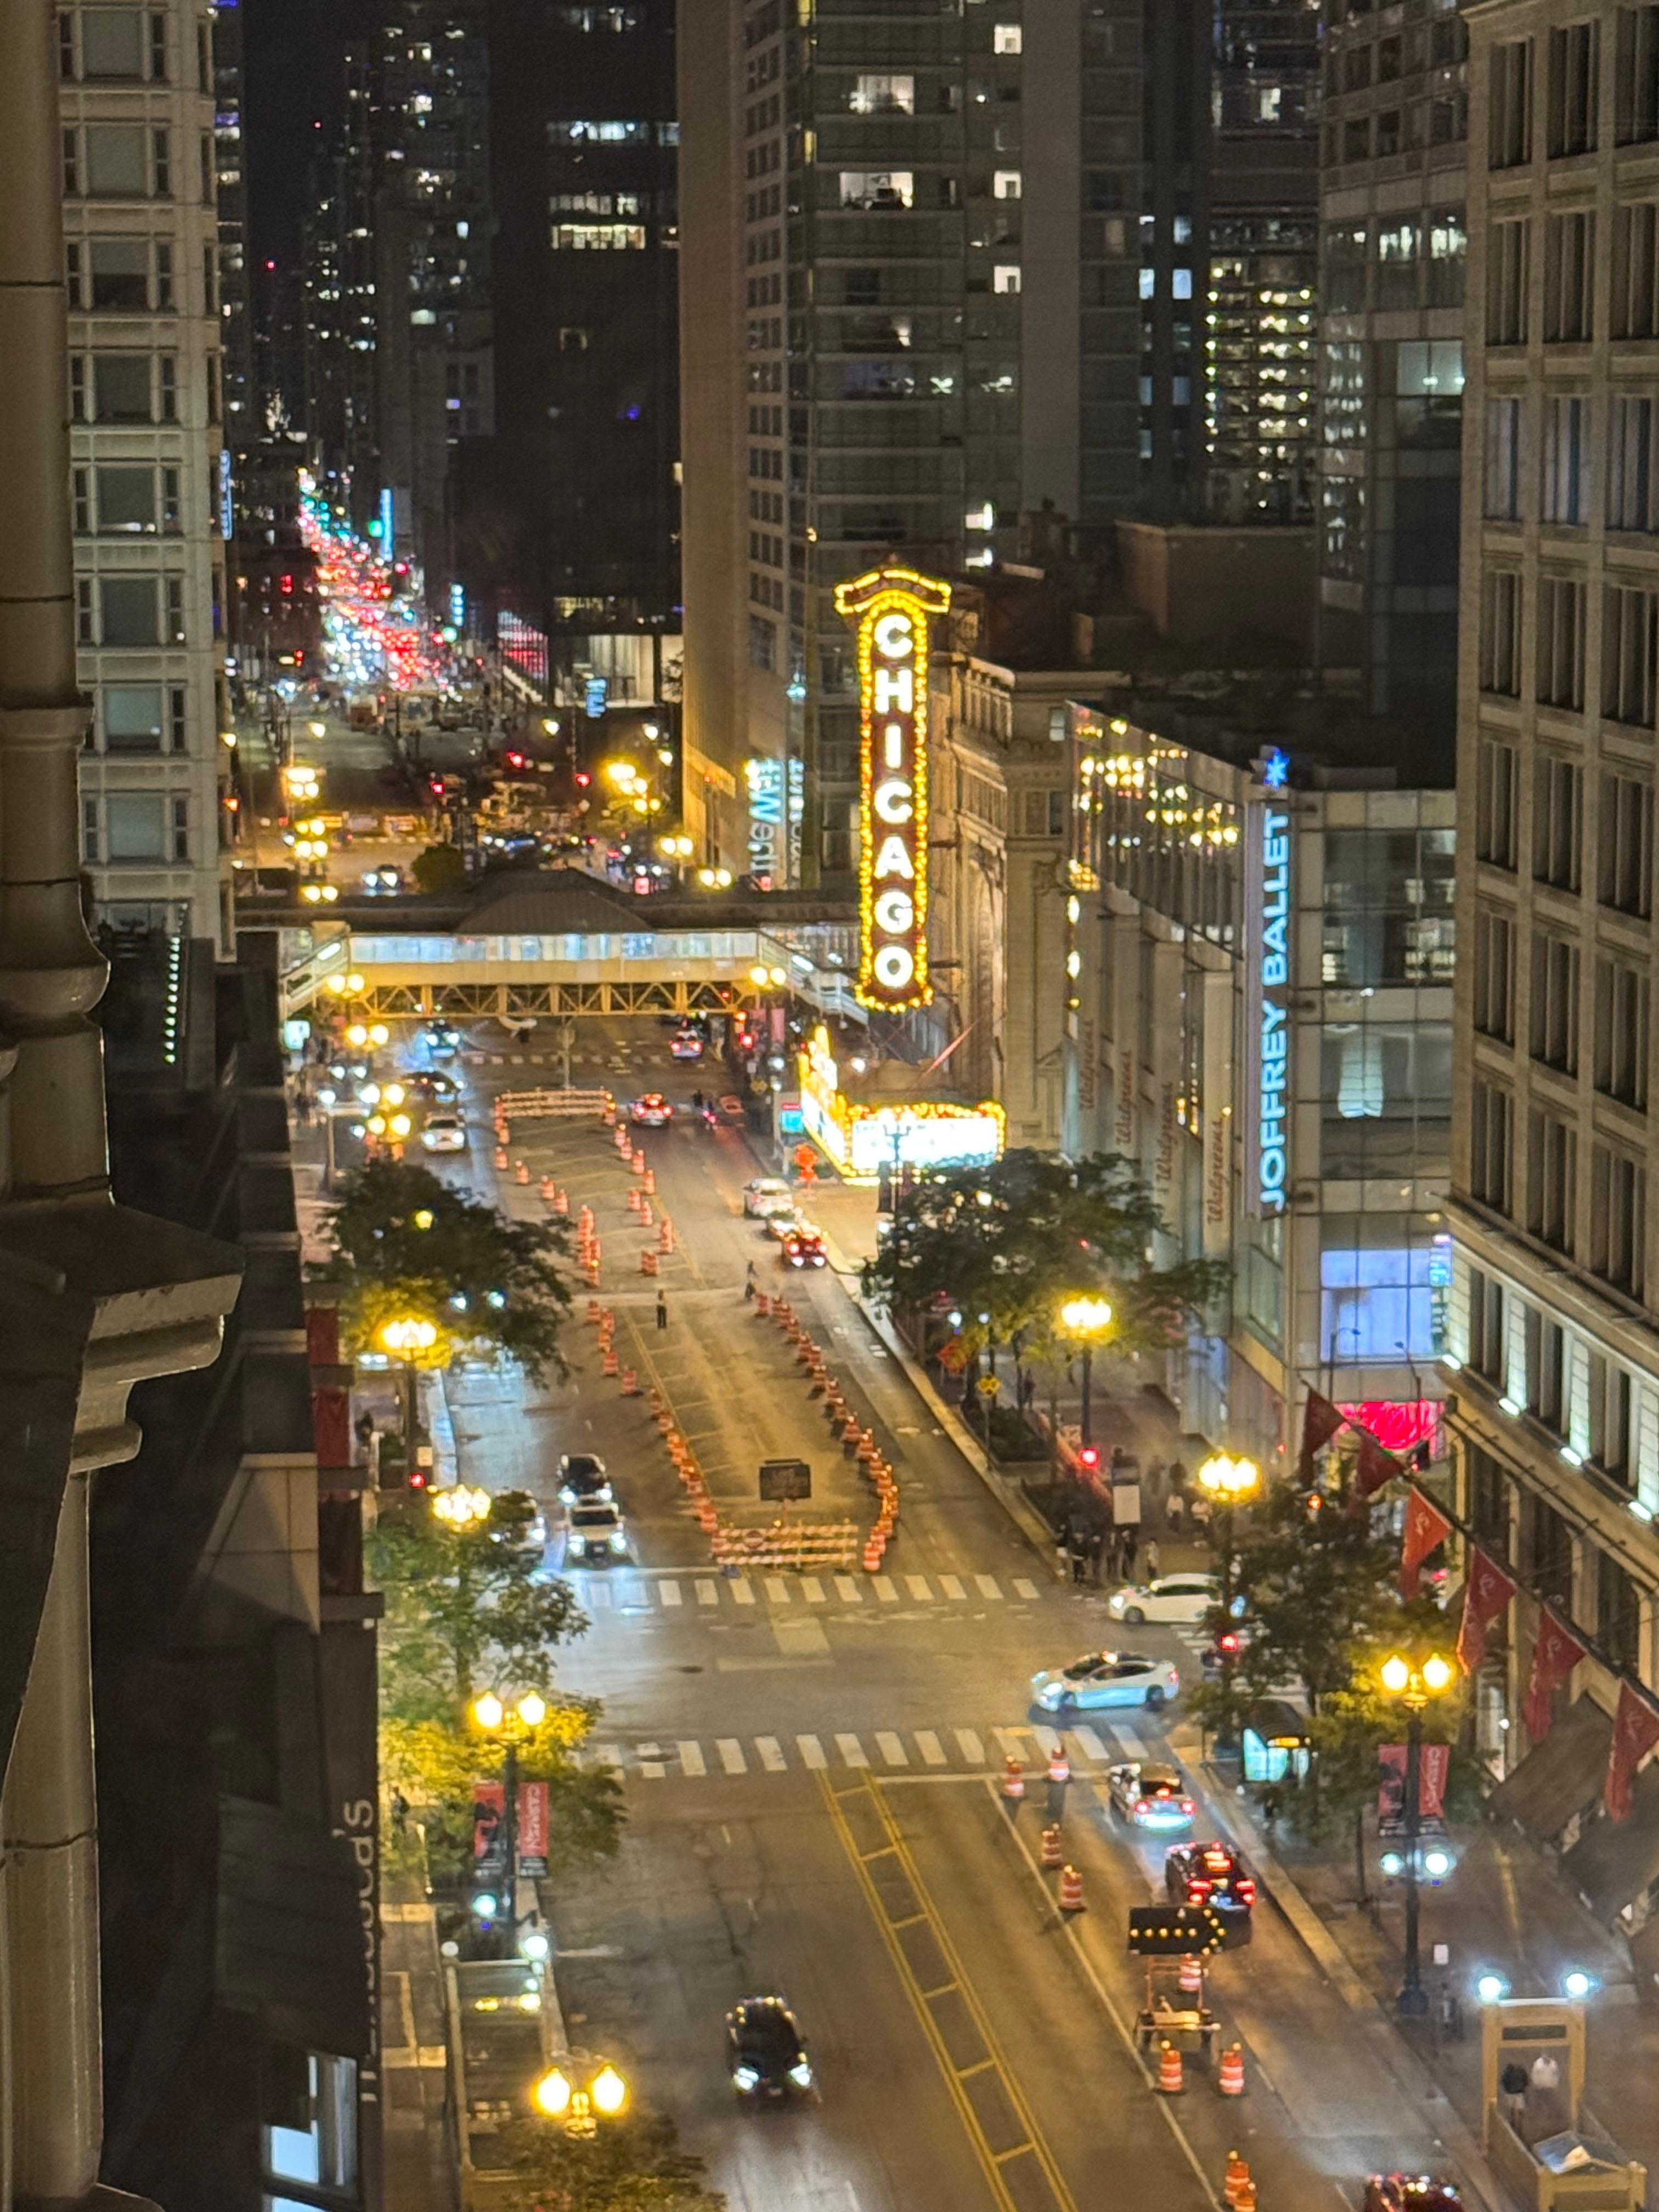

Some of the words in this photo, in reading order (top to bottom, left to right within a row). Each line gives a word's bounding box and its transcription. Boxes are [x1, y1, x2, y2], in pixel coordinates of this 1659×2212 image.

[874, 614, 913, 988] CHICAGO
[1262, 808, 1289, 986] BALLET
[1207, 1116, 1229, 1224] Walgreens
[1260, 1000, 1287, 1212] JOFFREY
